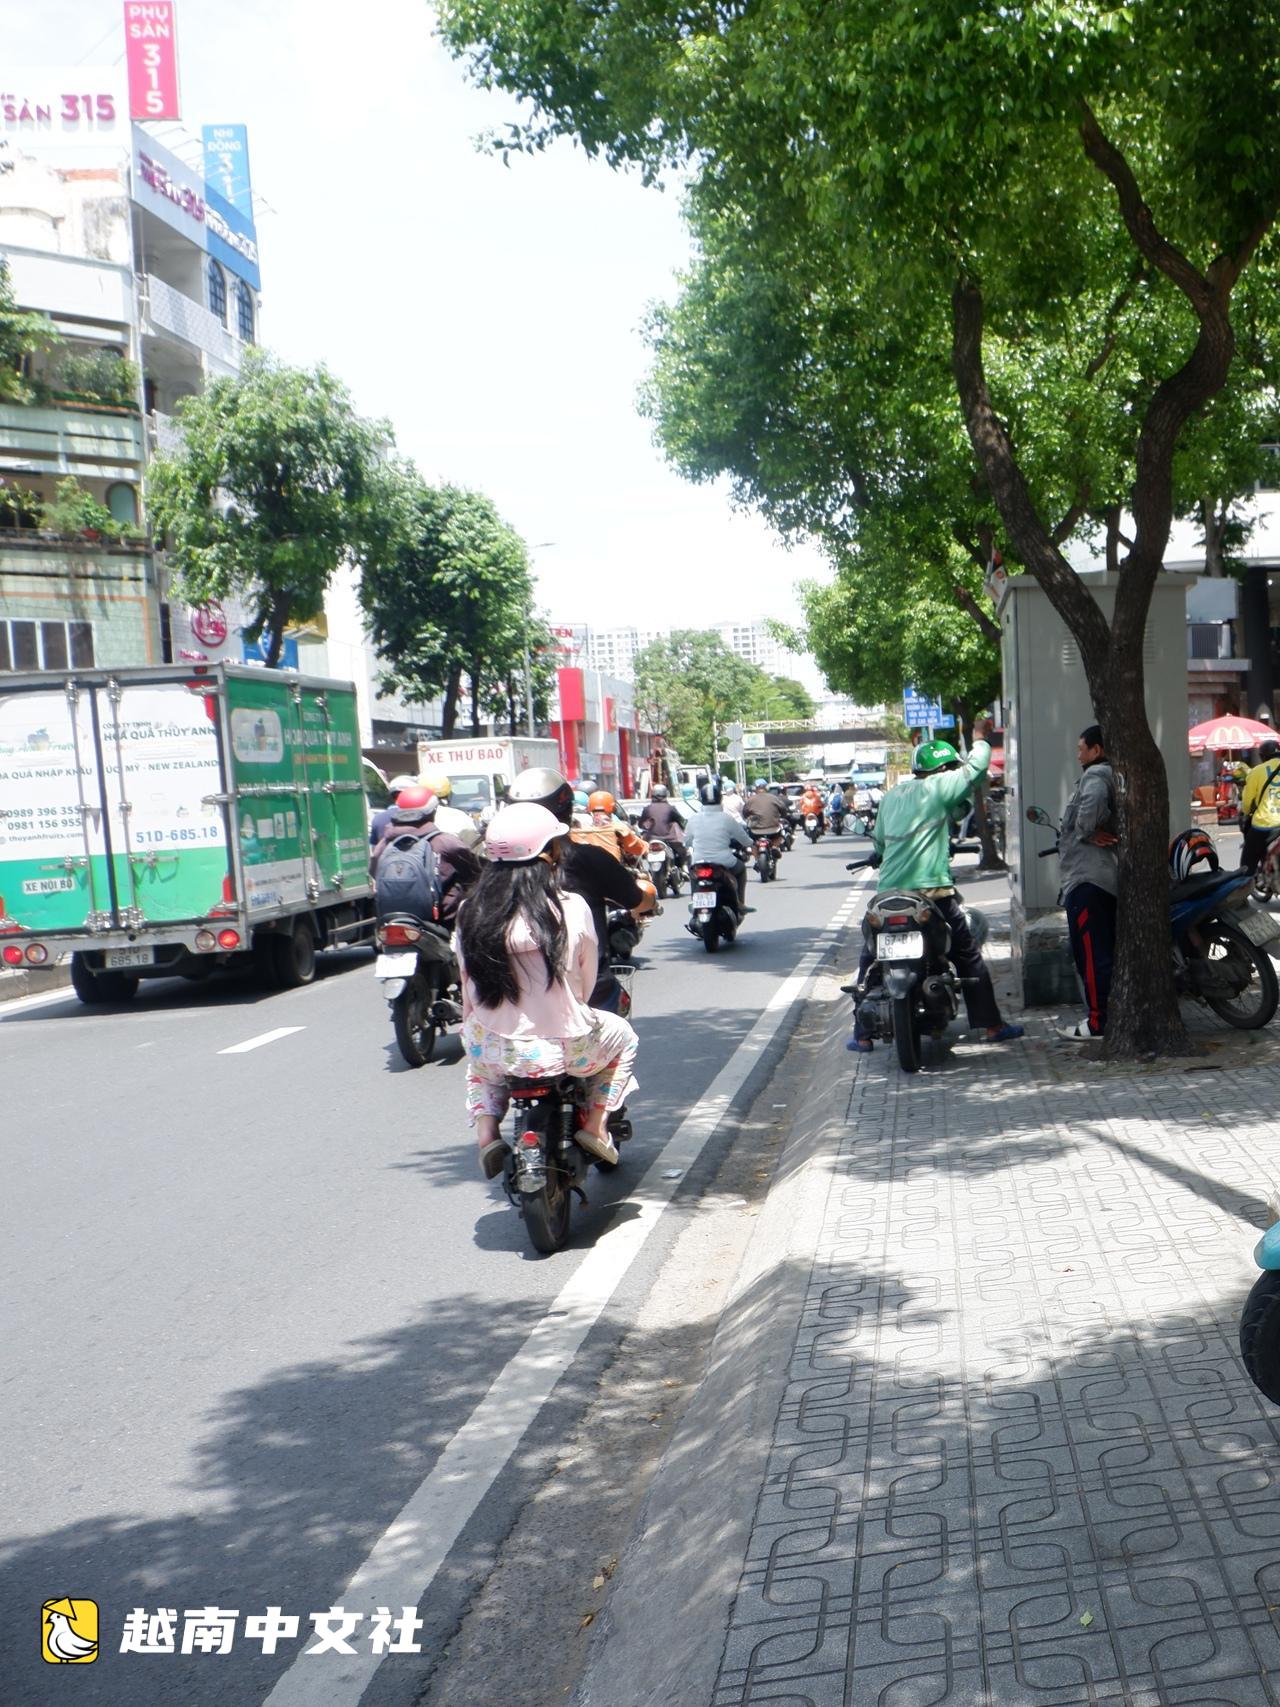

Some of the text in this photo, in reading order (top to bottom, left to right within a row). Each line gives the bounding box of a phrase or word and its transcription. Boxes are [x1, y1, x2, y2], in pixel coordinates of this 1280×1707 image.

[129, 7, 168, 21] PHỤ
[60, 94, 116, 122] 315
[191, 726, 217, 736] ANH
[428, 752, 445, 763] XE
[148, 761, 170, 771] NEW
[173, 759, 219, 770] ZEALAND
[7, 804, 81, 819] 0989 396 355
[8, 817, 82, 831] 0981 156 955
[136, 826, 218, 843] 51D-685.18
